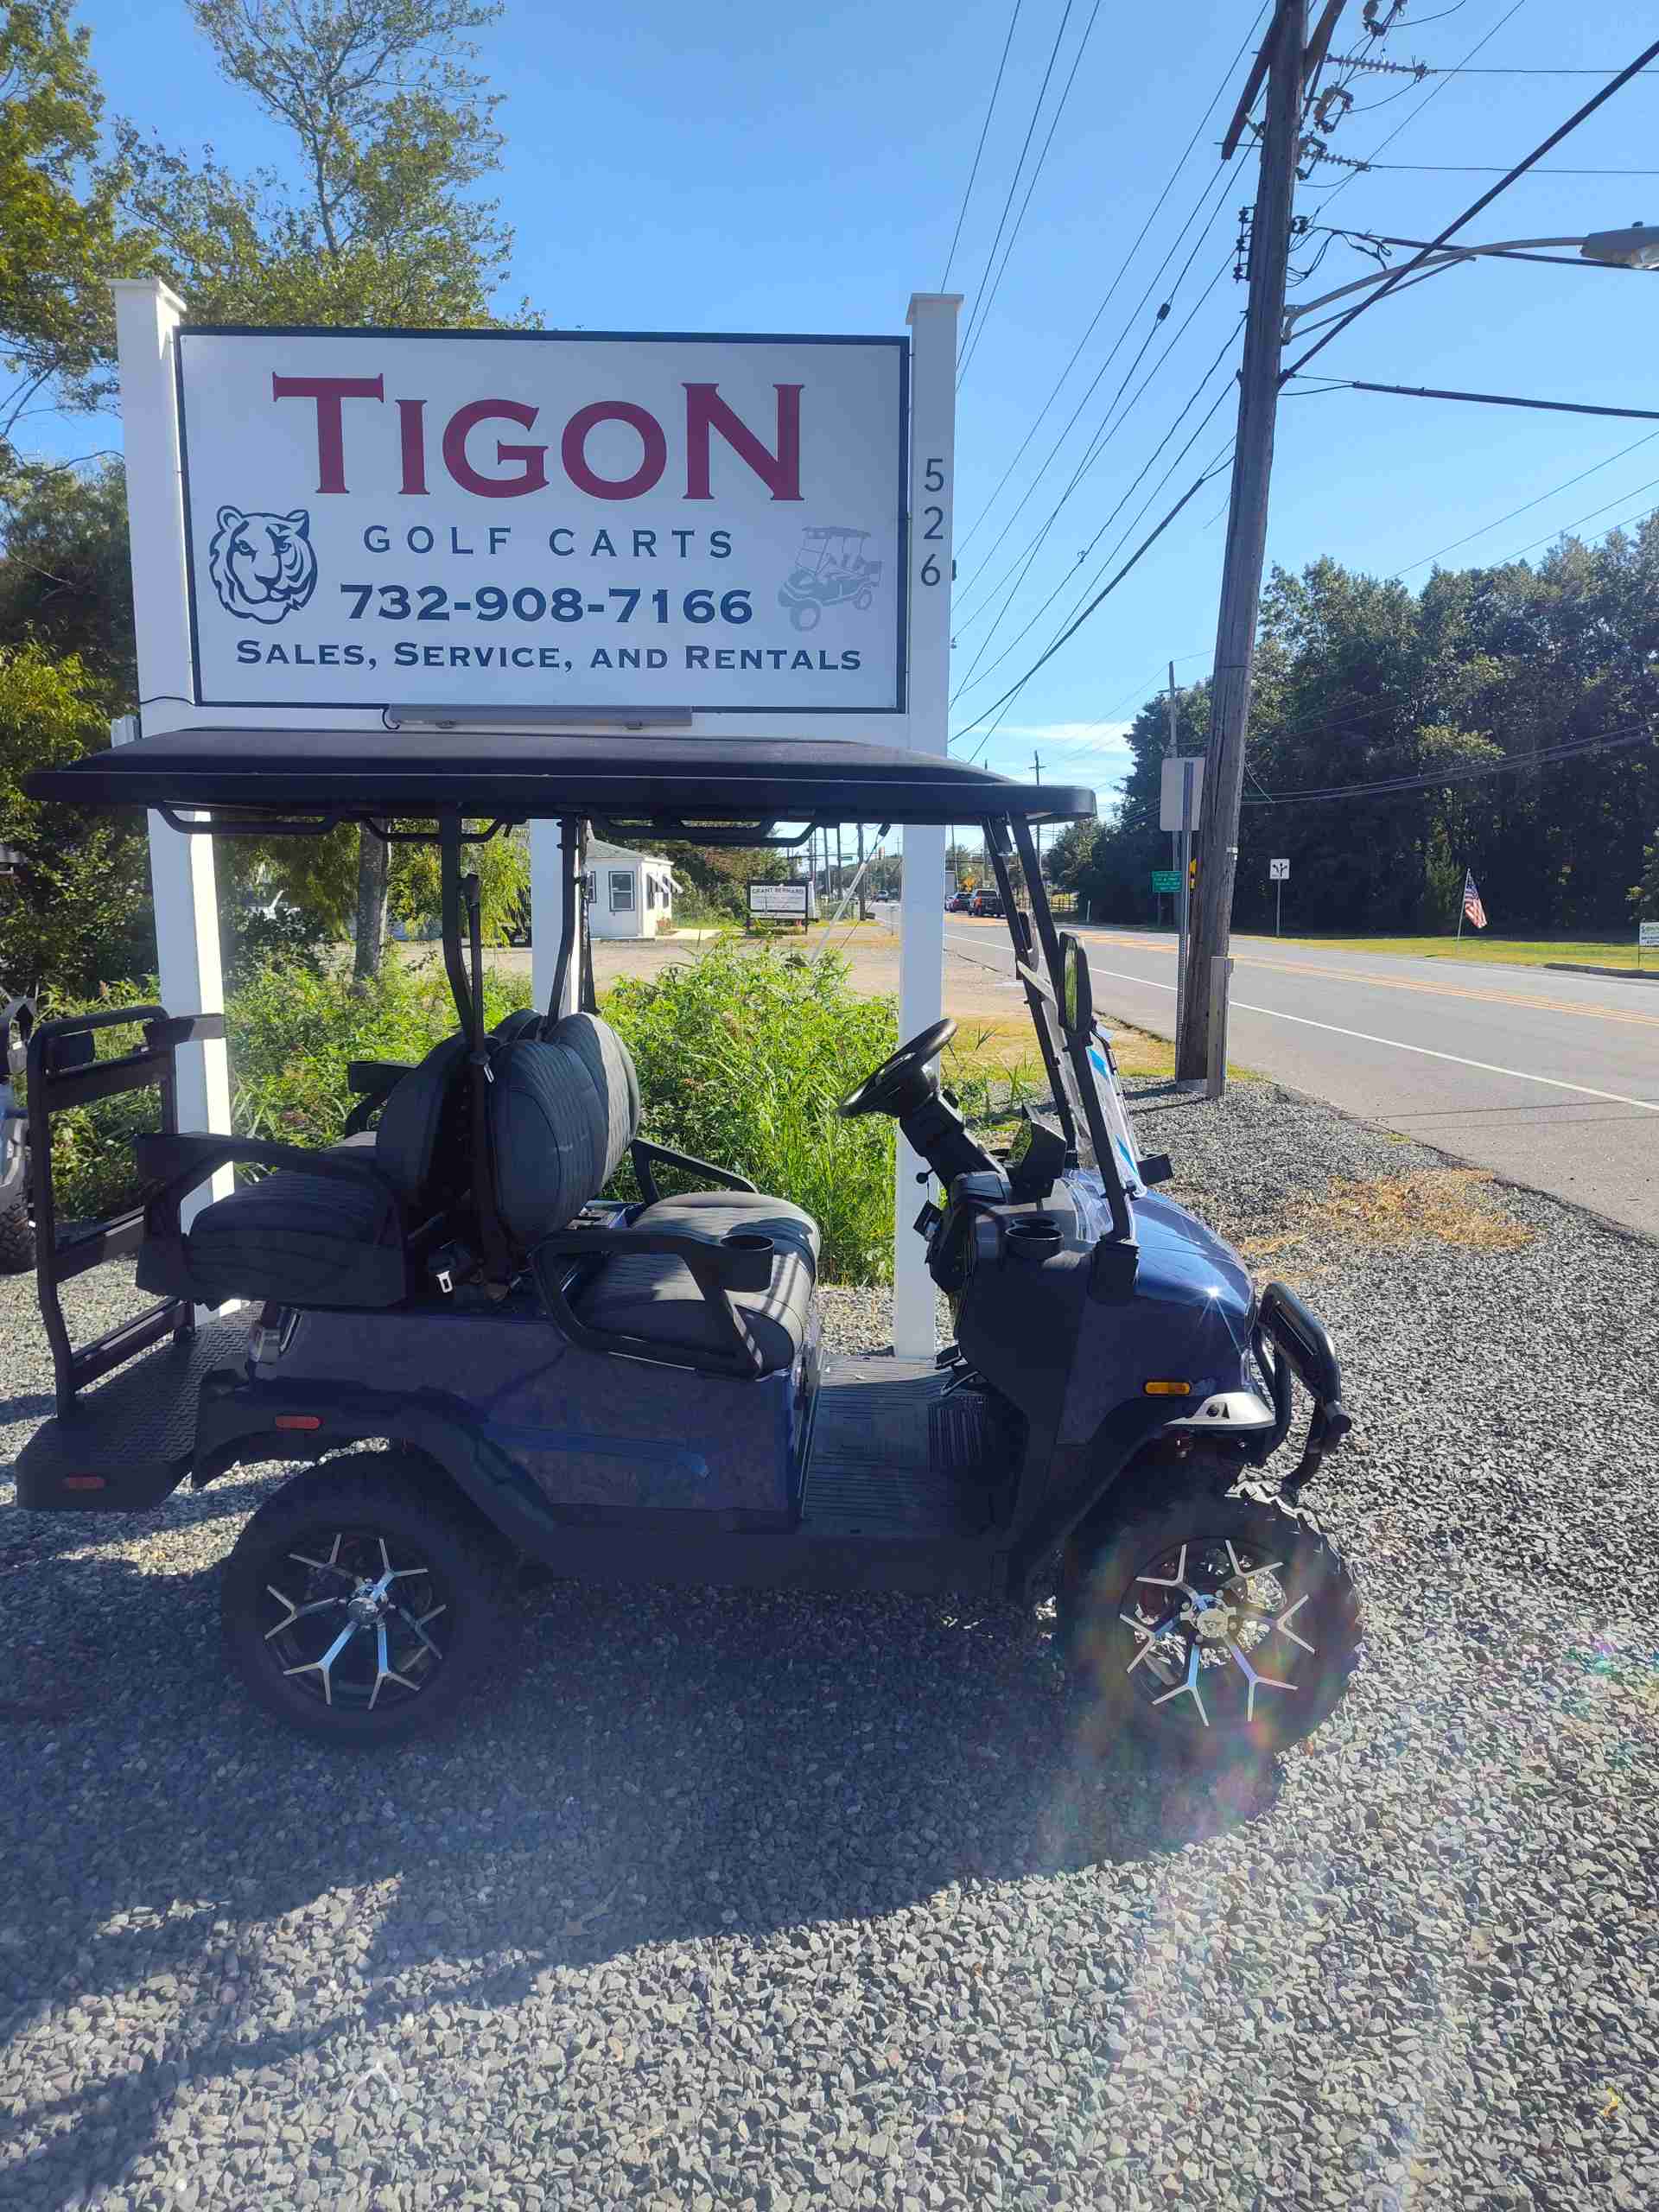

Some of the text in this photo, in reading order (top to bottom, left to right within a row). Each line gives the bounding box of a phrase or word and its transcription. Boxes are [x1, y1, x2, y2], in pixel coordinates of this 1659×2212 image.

[272, 372, 805, 500] TIGON
[364, 525, 733, 559] GOLF CARTS
[340, 584, 753, 625] 732-908-7166
[237, 640, 861, 673] SALES, SERVICE, AND RENTALS
